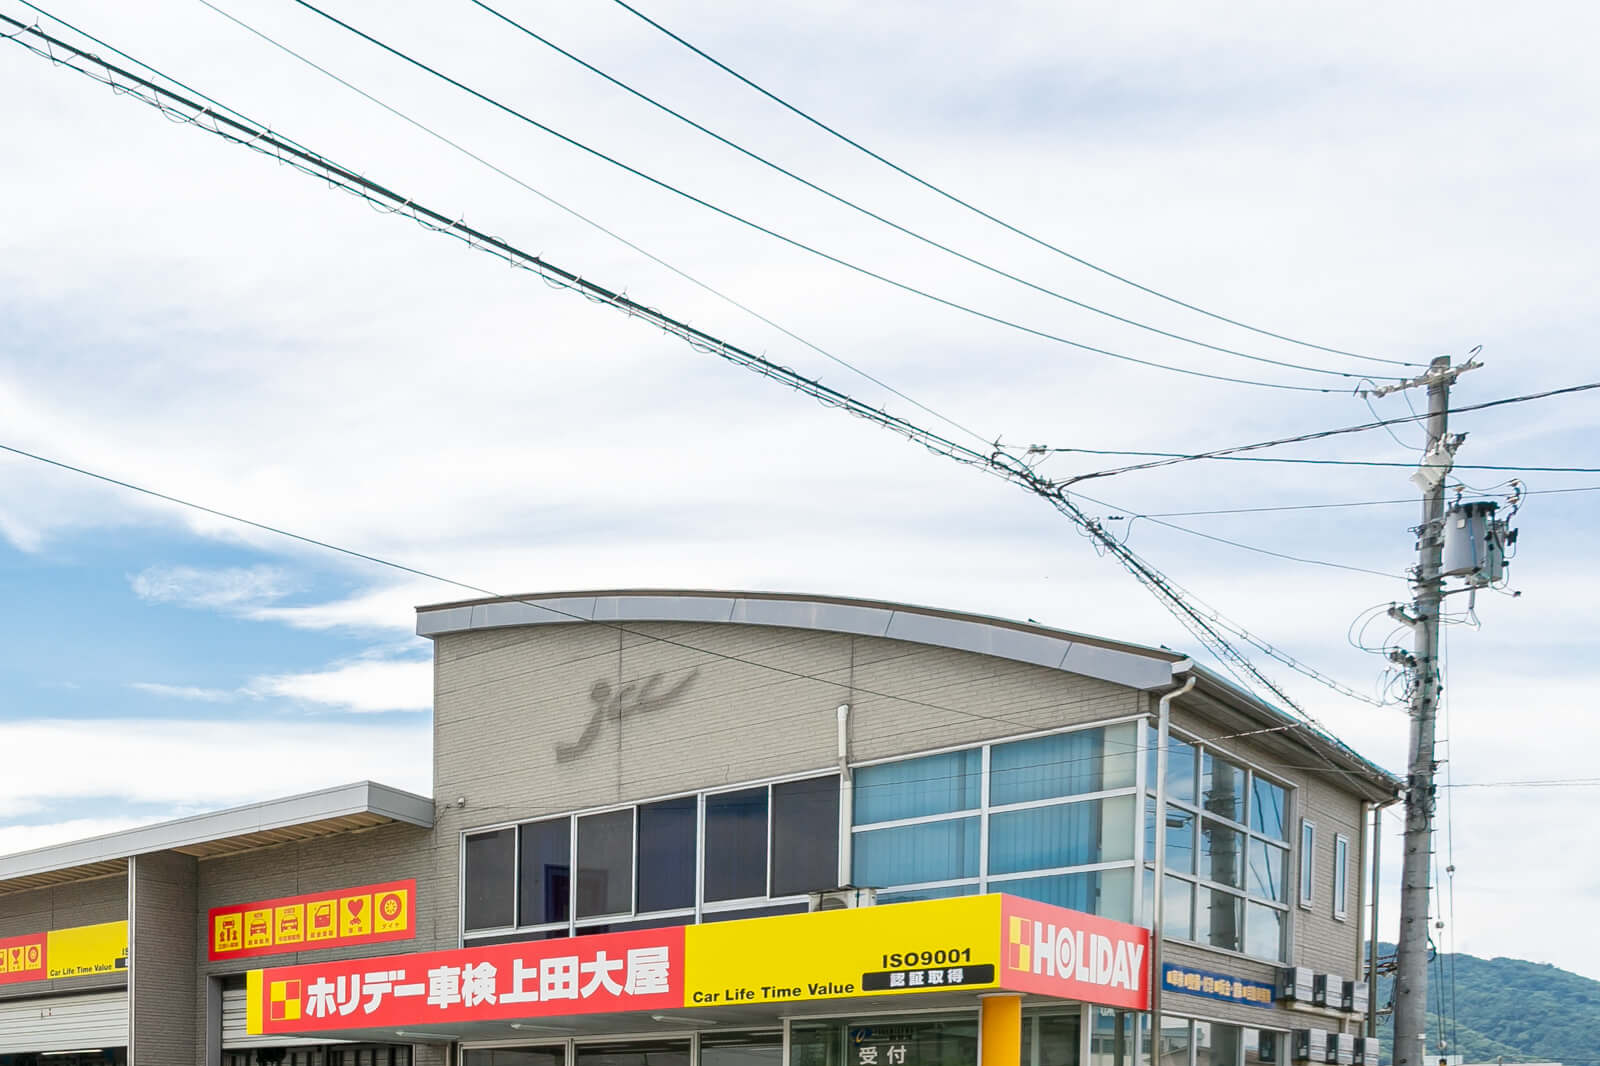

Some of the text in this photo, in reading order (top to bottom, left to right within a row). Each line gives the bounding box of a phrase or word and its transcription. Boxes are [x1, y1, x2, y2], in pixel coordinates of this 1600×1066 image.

[882, 947, 972, 969] ISO9001
[1032, 921, 1145, 992] HOLIDAY
[50, 963, 112, 977] Car Life Time Value
[889, 967, 965, 988] 認証取得
[304, 946, 671, 1018] ホリデー車検上田大屋
[692, 980, 855, 1004] Car Life Time Value
[858, 1045, 907, 1065] 受付
